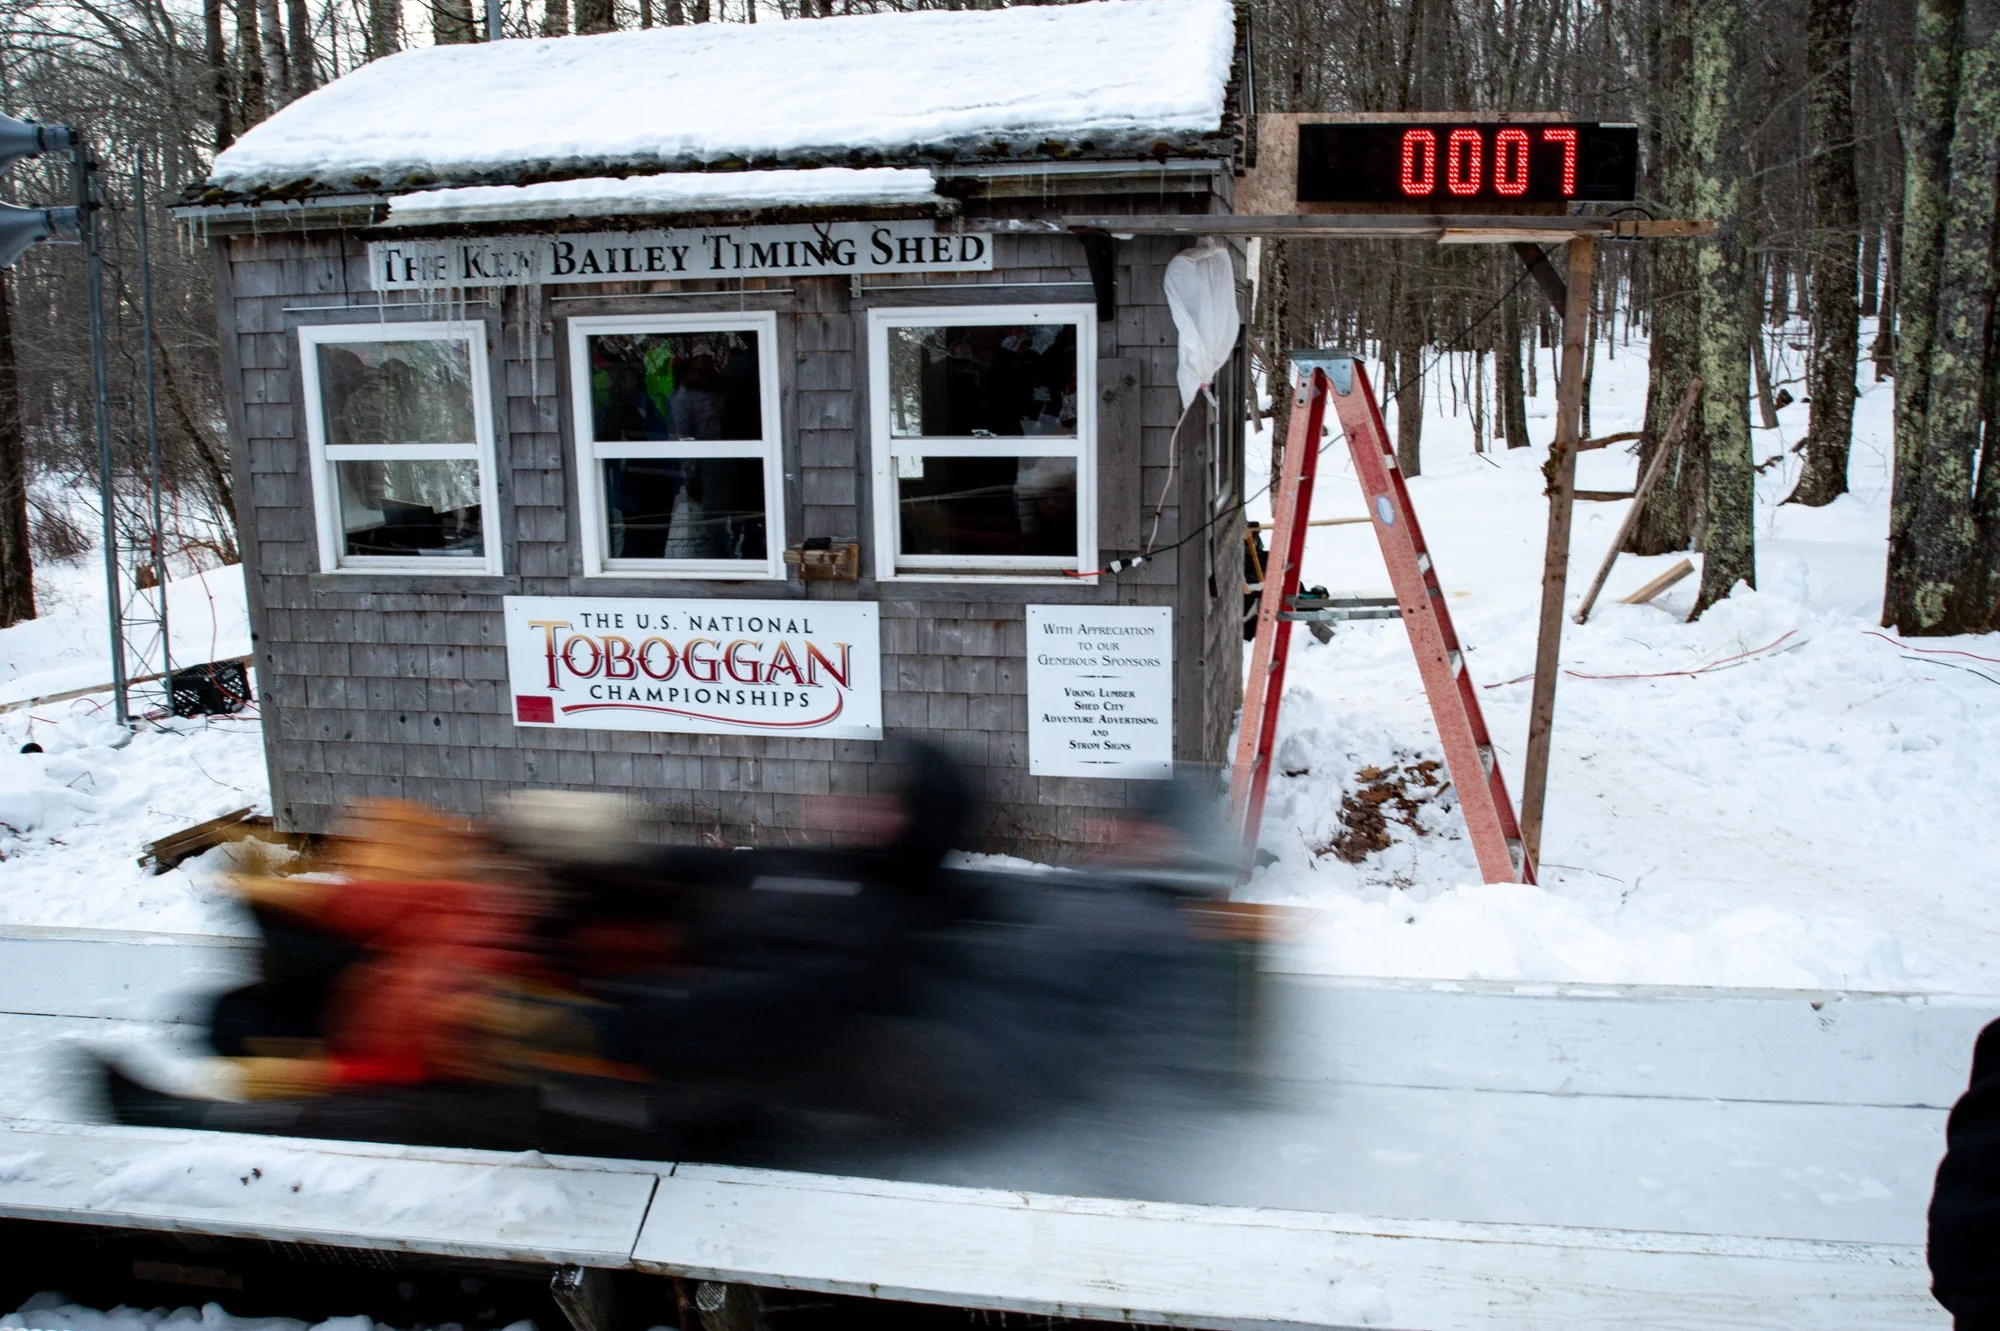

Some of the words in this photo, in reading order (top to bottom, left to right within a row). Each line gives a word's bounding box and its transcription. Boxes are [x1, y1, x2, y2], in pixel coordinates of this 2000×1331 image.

[1402, 129, 1577, 196] 0007
[580, 612, 624, 630] THE
[636, 614, 678, 631] U.S.
[689, 615, 814, 634] NATIONAL
[528, 619, 854, 692] TOBOGGAN
[1078, 642, 1092, 651] TO
[1097, 642, 1120, 651] OUR
[590, 684, 810, 708] CHAMPIONSHIPS
[1091, 729, 1109, 737] AND
